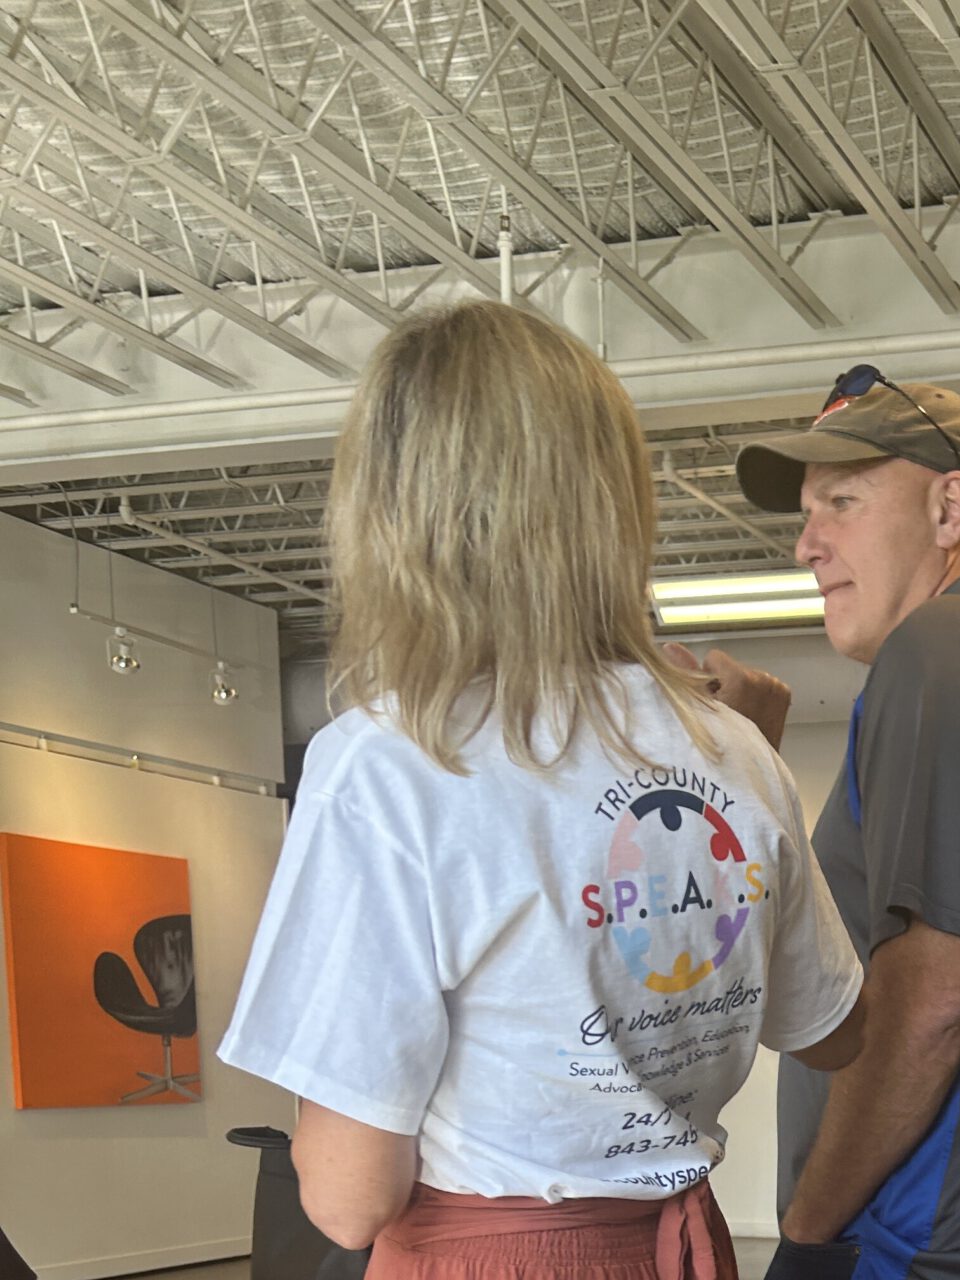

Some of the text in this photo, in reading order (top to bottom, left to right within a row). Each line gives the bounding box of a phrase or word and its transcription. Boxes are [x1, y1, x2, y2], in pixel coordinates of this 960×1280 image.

[594, 766, 735, 821] TRI-COUNTY
[580, 976, 762, 1046] Or voice matters
[569, 1062, 618, 1077] Sexual
